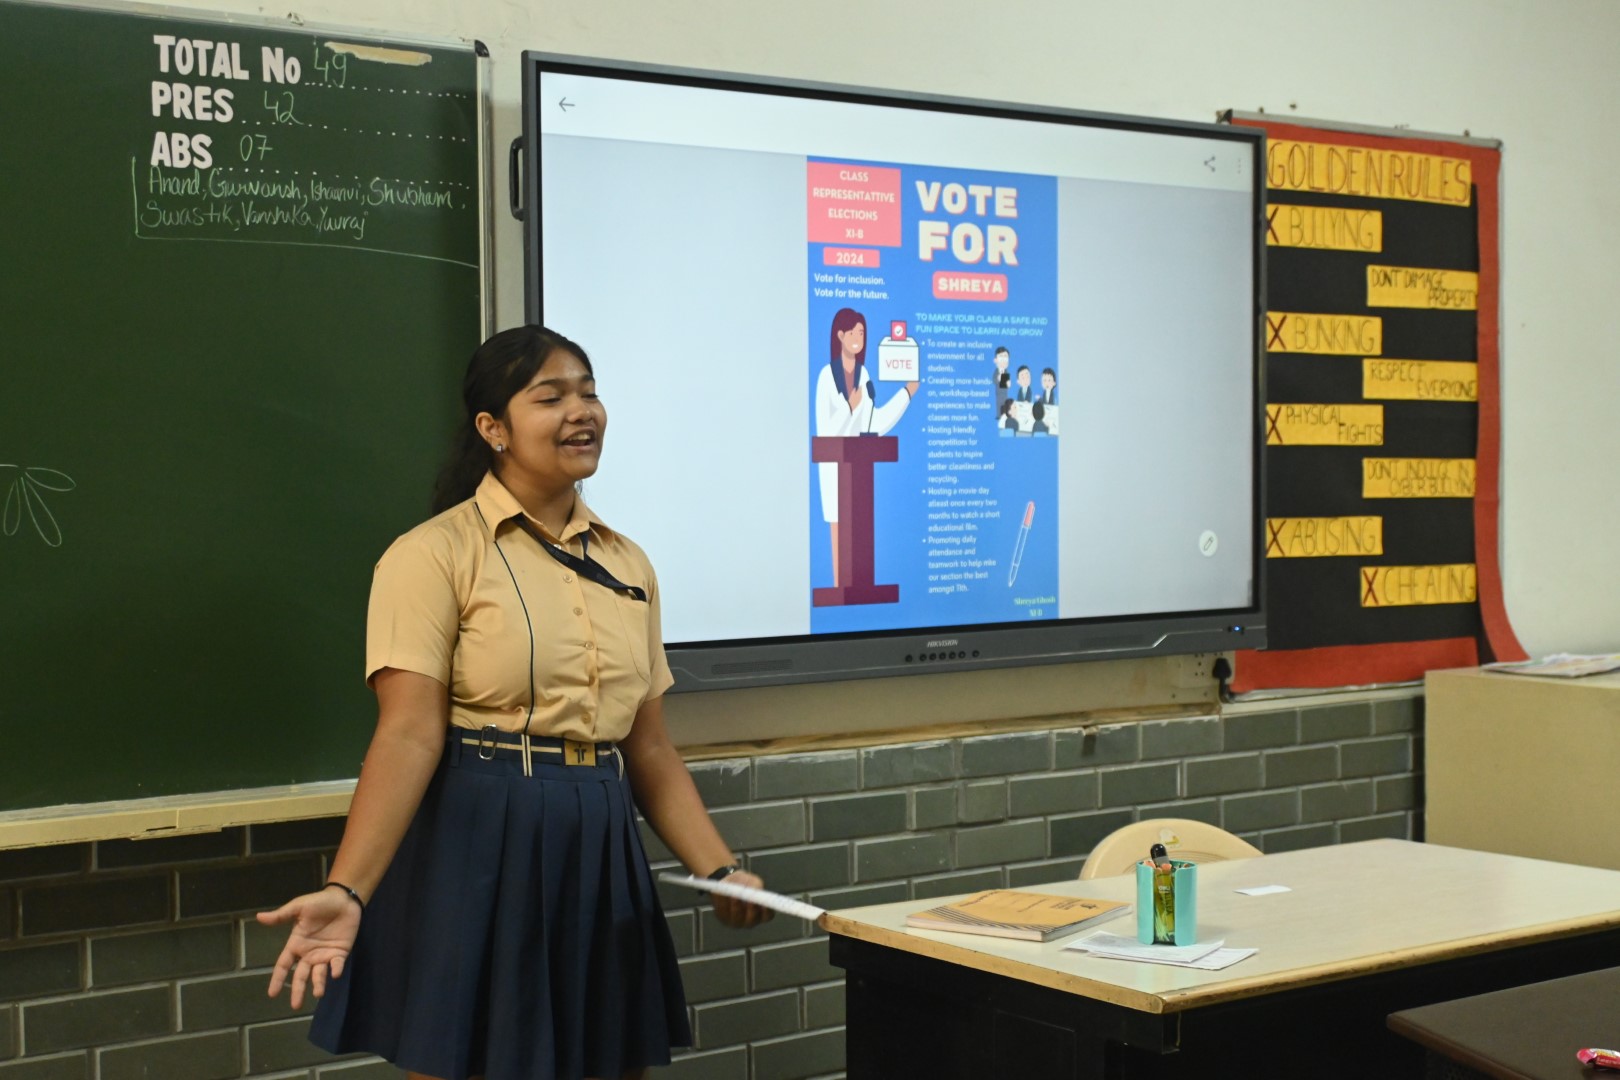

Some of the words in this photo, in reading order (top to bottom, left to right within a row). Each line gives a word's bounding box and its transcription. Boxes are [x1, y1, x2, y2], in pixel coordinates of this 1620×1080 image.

[152, 34, 249, 81] TOTAL
[261, 46, 301, 85] No
[313, 46, 347, 87] 49
[151, 80, 234, 124] PRES
[263, 91, 304, 126] 42
[150, 131, 213, 170] ABS
[239, 133, 274, 162] 07
[839, 170, 869, 183] CLASS
[1267, 142, 1383, 196] GOLDEN
[1388, 153, 1470, 203] RULES
[812, 187, 895, 204] REPRESENTATTIVE
[915, 180, 1018, 218] VOTE
[828, 208, 878, 221] ELECTIONS
[845, 228, 864, 239] XI-B
[918, 219, 1019, 266] FOR
[836, 252, 864, 265] 2024
[814, 273, 834, 284] Vote
[834, 273, 846, 284] for
[847, 274, 886, 286] inclusion.
[938, 277, 1003, 294] SHREYA
[814, 288, 834, 298] Vote
[834, 288, 847, 298] for
[848, 288, 862, 299] the
[863, 289, 890, 300] future.
[915, 313, 927, 321] TO
[929, 313, 952, 321] MAKE
[954, 314, 975, 322] YOUR
[976, 315, 1002, 323] CLASS
[1003, 316, 1010, 324] A
[1011, 316, 1030, 324] SAFE
[1031, 317, 1048, 325] AND
[915, 325, 933, 333] FUN
[933, 326, 960, 334] SPACE
[961, 326, 972, 334] TO
[973, 327, 1000, 335] LEARN
[1001, 328, 1018, 336] AND
[1018, 328, 1044, 336] GROW
[1294, 315, 1375, 354] BUNKING
[927, 339, 935, 347] To
[937, 340, 957, 348] create
[958, 340, 966, 348] an
[967, 352, 975, 360] for
[976, 353, 985, 361] all
[885, 359, 913, 370] VOTE
[1370, 361, 1427, 382] RESPECT
[927, 377, 955, 386] Creating
[956, 377, 972, 386] more
[1416, 379, 1477, 399] EVERYONE
[927, 402, 965, 410] experiences
[966, 402, 974, 410] to
[974, 401, 991, 409] make
[1285, 405, 1346, 426] PHYSICAL
[927, 426, 952, 435] Hosting
[953, 426, 976, 435] friendly
[1337, 424, 1383, 444] FIGHTS
[927, 438, 967, 446] competitions
[968, 438, 977, 446] for
[927, 450, 953, 458] students
[954, 450, 962, 458] to
[928, 463, 947, 471] better
[949, 462, 982, 470] cleanliness
[983, 462, 995, 470] and
[928, 487, 952, 496] Hosting
[958, 486, 977, 495] movie
[978, 486, 990, 495] day
[950, 500, 965, 508] once
[966, 500, 984, 508] every
[985, 499, 998, 507] two
[928, 512, 950, 520] months
[951, 512, 959, 520] to
[960, 511, 979, 519] watch
[985, 511, 1000, 519] short
[928, 524, 964, 532] educational
[928, 536, 961, 545] Promoting
[962, 535, 977, 544] daily
[1290, 517, 1377, 556] ABUSING
[928, 549, 963, 557] attendance
[964, 548, 976, 556] and
[928, 561, 959, 569] teamwork
[960, 560, 967, 568] to
[968, 560, 983, 568] help
[928, 574, 939, 582] our
[940, 573, 963, 581] section
[963, 572, 974, 580] the
[975, 571, 988, 579] best
[928, 586, 955, 595] amongst
[1382, 565, 1476, 605] CHEATING
